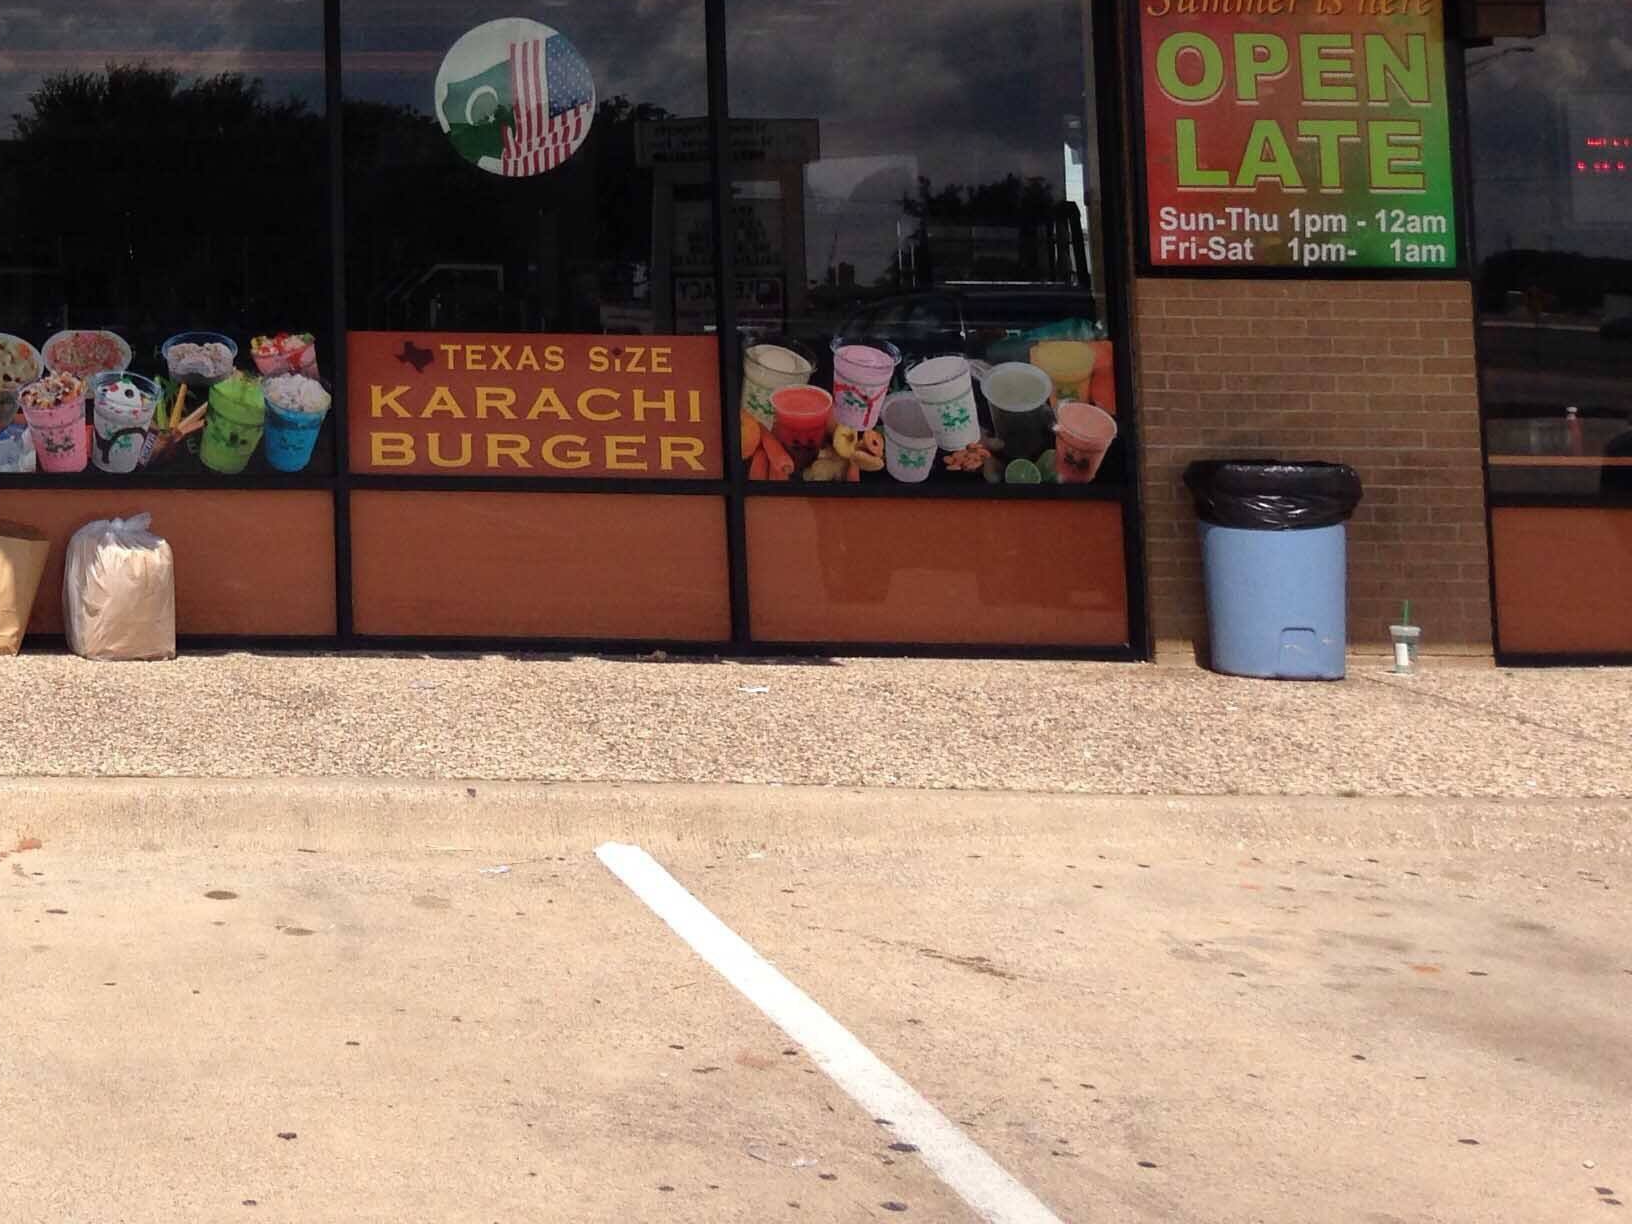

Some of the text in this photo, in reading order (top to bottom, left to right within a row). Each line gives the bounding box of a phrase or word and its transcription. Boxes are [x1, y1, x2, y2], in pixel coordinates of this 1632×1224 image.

[1155, 30, 1432, 107] OPEN
[1174, 118, 1427, 194] LATE
[1158, 206, 1279, 232] Sun-Thu
[1288, 208, 1347, 237] 1pm
[1374, 209, 1447, 233] 12am
[1158, 236, 1254, 261] Fri-Sat
[1389, 239, 1447, 263] 1am
[440, 344, 566, 373] TEXAS
[370, 385, 702, 423] KARACHI
[369, 431, 707, 472] BURGER
